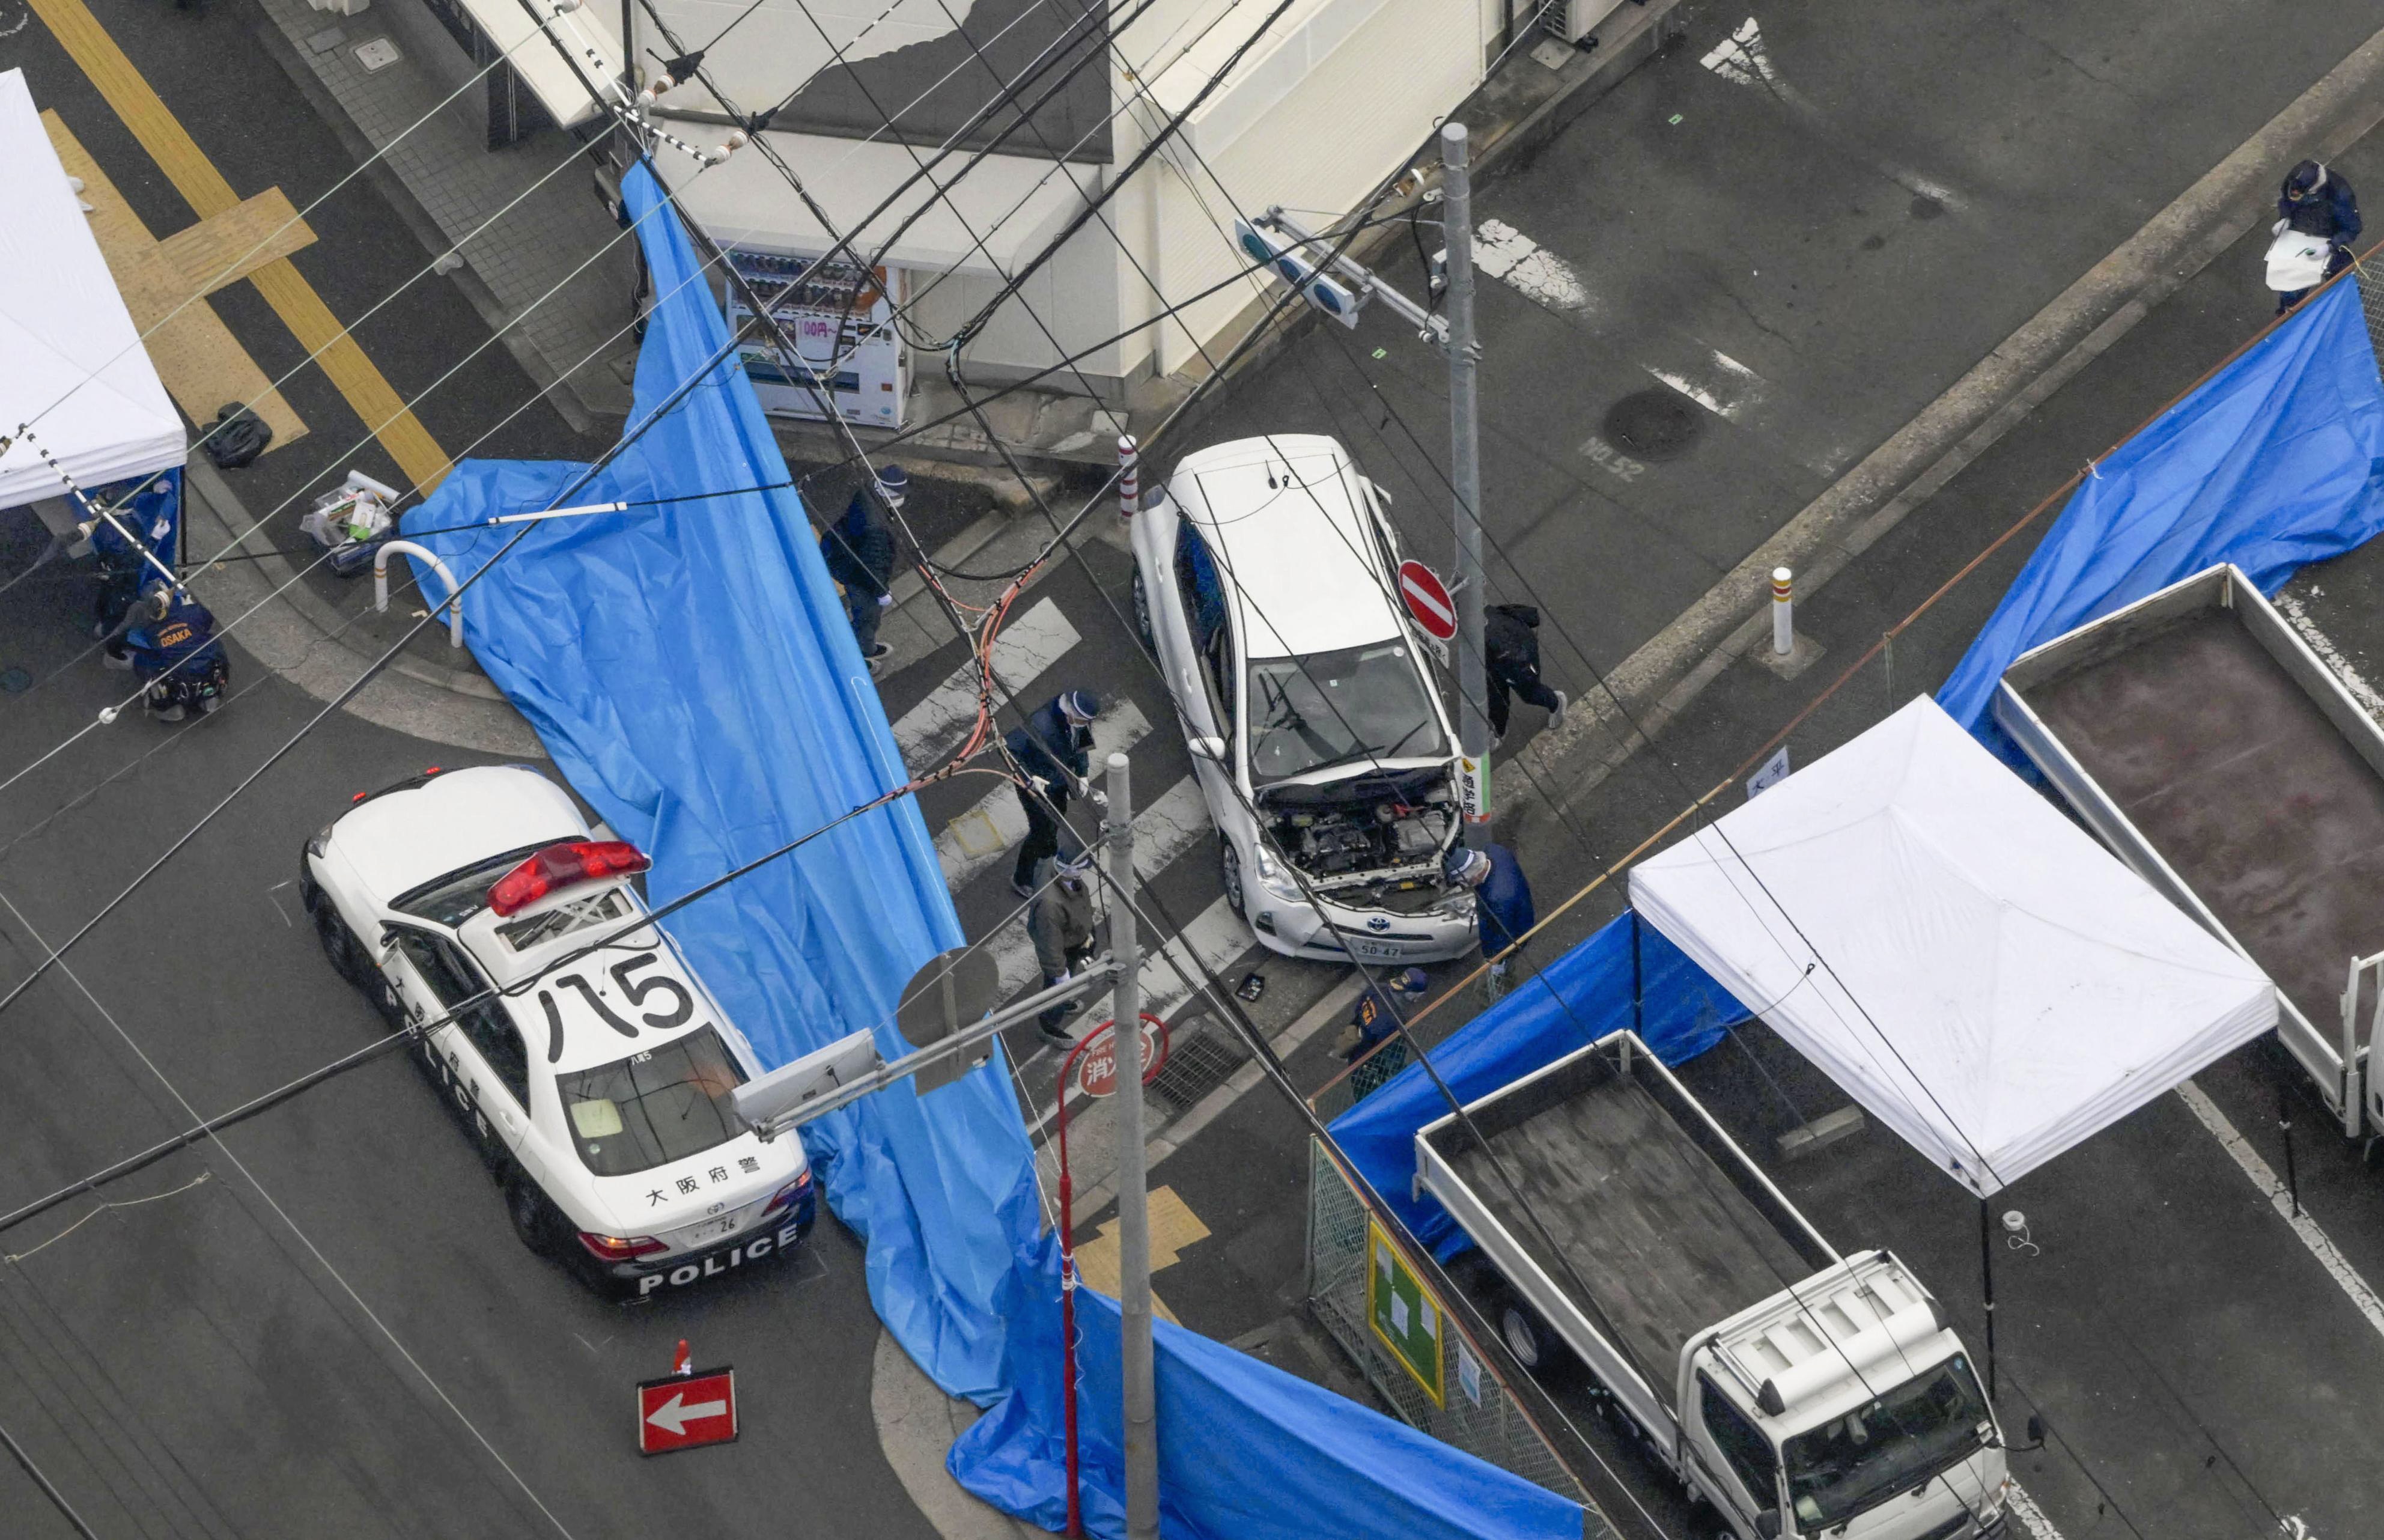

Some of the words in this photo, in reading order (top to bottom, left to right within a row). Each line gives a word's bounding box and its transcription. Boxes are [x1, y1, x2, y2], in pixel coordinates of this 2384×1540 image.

[160, 628, 192, 647] OSAKA
[385, 985, 488, 1139] POLICE
[646, 1156, 761, 1207] 大阪府警
[639, 1223, 798, 1295] POLICE
